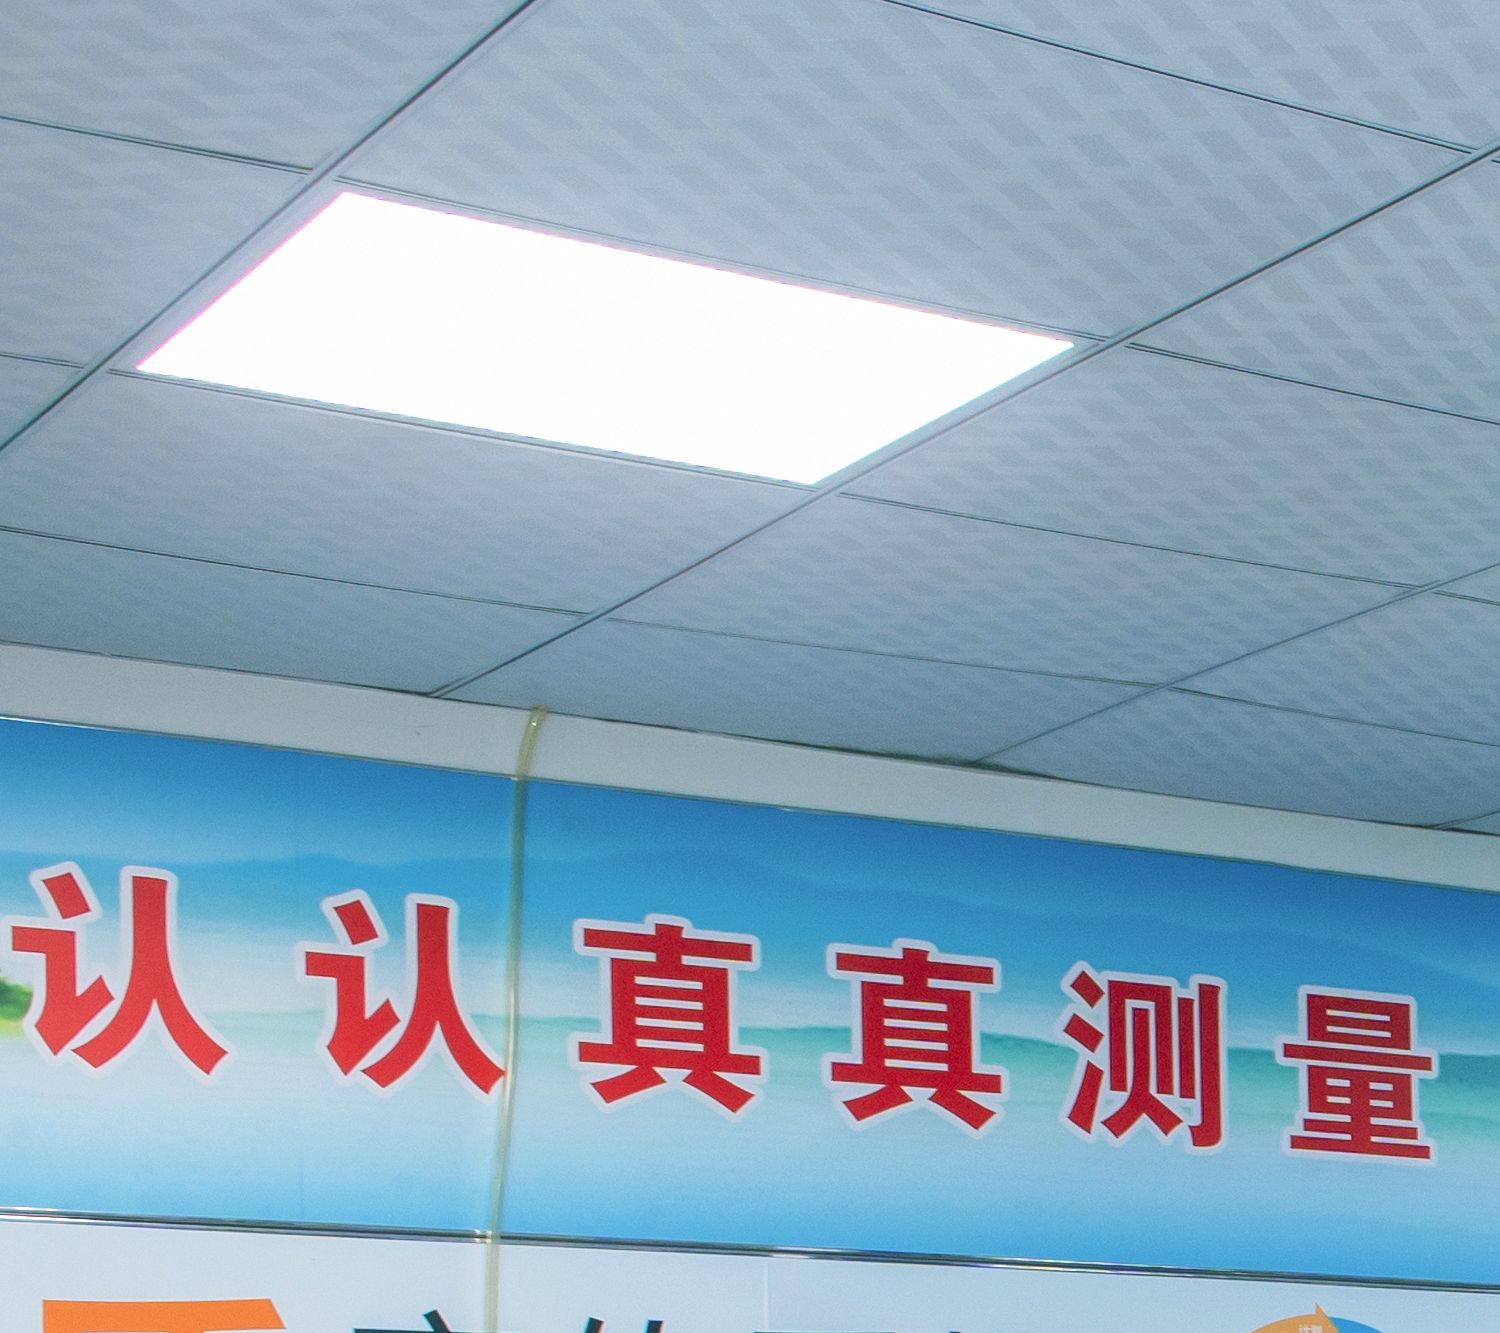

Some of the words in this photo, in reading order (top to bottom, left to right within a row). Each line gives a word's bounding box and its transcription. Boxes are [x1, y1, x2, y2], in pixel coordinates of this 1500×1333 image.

[10, 868, 1437, 1161] 认认真真测量
